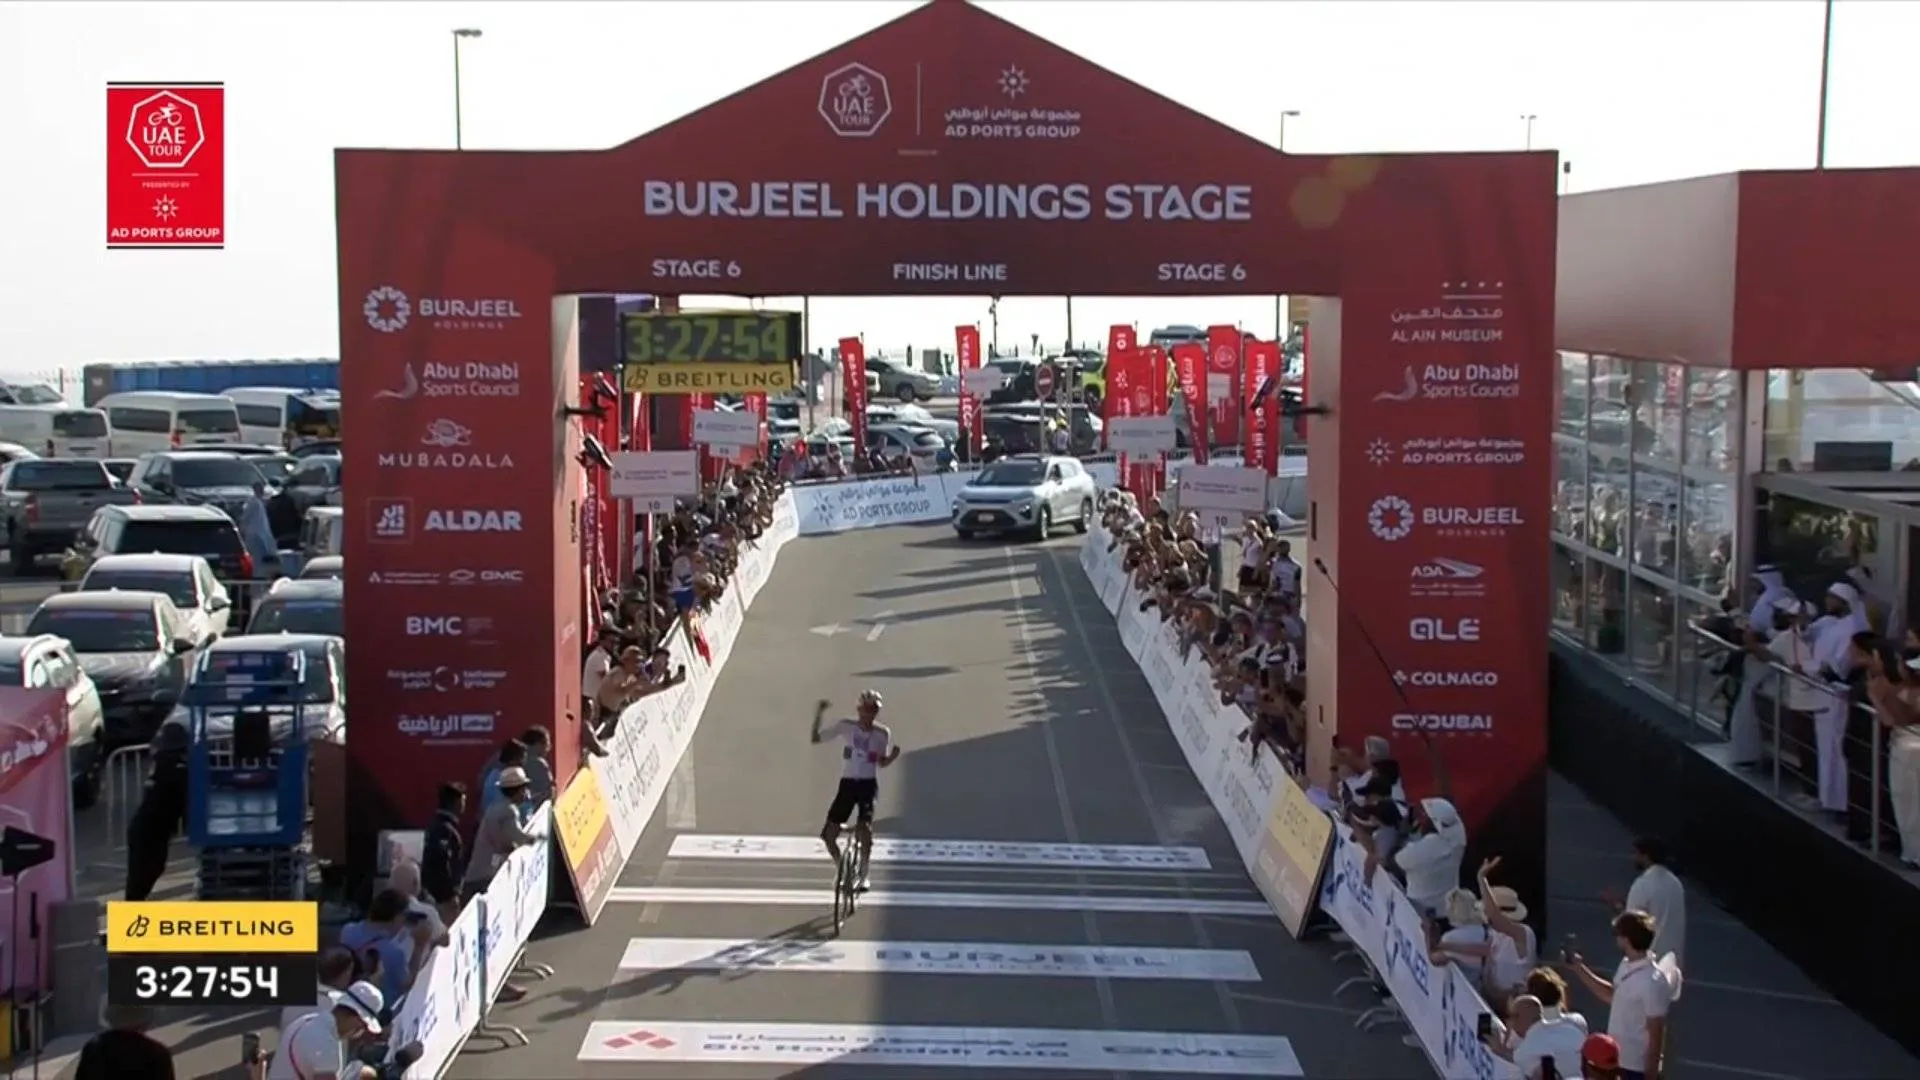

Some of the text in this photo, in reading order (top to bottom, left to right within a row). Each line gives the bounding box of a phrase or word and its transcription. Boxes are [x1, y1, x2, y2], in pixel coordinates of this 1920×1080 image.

[833, 97, 875, 114] UAE
[839, 114, 871, 126] TOUR
[945, 125, 1081, 138] AD PORTS GROUP
[643, 180, 1252, 220] BURJEEL HOLDINGS STAGE
[652, 259, 742, 278] STAGE 6
[893, 263, 1008, 280] FINISH LINE
[1157, 263, 1247, 281] STAGE 6
[419, 298, 522, 317] BURJEEL
[625, 320, 788, 361] 3:27:54
[1391, 329, 1503, 342] AL AIN MUSEUM
[423, 362, 519, 379] Abu Dhabi
[1423, 364, 1520, 380] Abu Dhabi
[657, 371, 785, 388] BREITLING
[423, 381, 519, 397] Sports Council
[1422, 383, 1520, 399] Sports Council
[378, 453, 514, 468] MUBADALA
[1403, 453, 1525, 464] AD PORTS GROUP
[859, 503, 893, 519] PORTS
[893, 499, 931, 515] GROUP
[1423, 507, 1525, 524] BURJEEL
[424, 510, 523, 531] ALDAR
[1214, 516, 1228, 526] 10
[480, 569, 524, 581] GMC
[406, 616, 462, 636] BMC
[1411, 672, 1498, 686] COLNAGO
